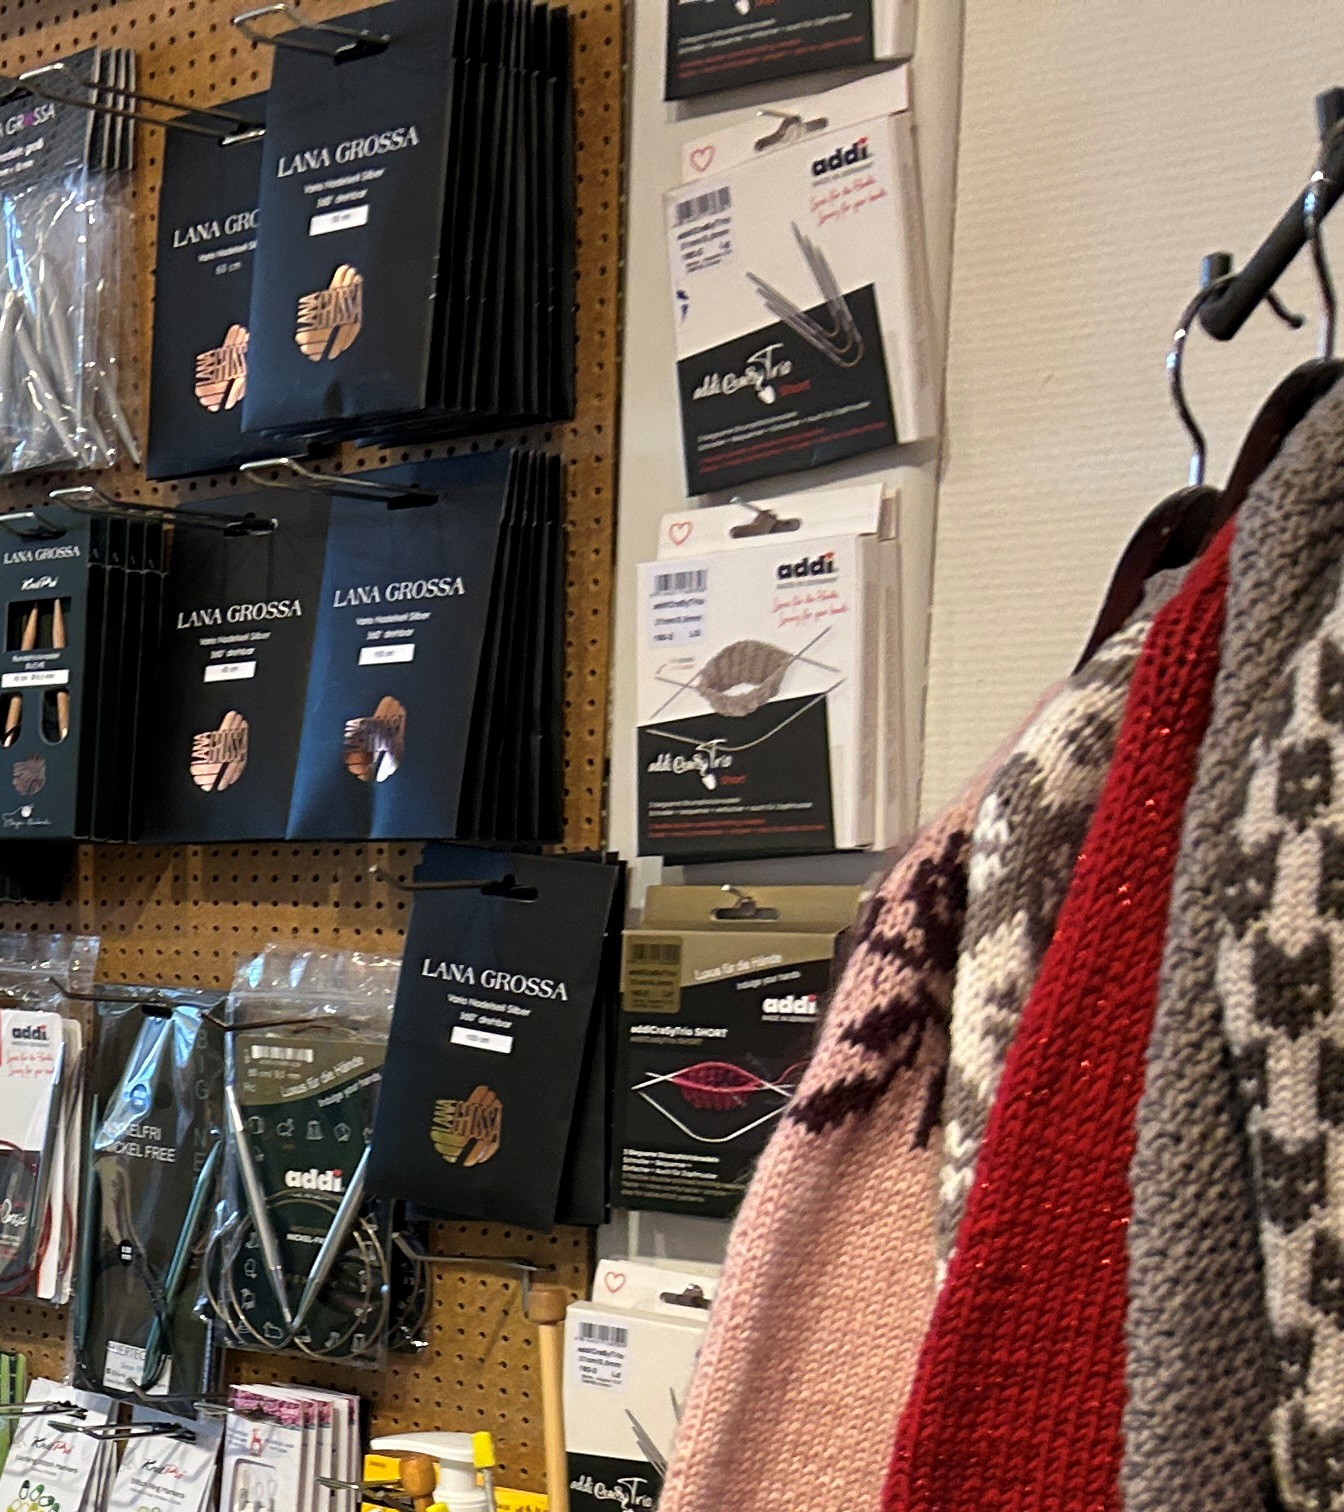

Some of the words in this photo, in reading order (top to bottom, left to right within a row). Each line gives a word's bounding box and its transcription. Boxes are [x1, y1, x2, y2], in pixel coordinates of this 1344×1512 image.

[277, 149, 330, 178] LANA
[335, 126, 420, 165] GROSSA
[812, 136, 869, 177] addi
[172, 220, 220, 249] LANA
[3, 551, 34, 565] LANA
[34, 545, 81, 561] GROSSA
[777, 551, 836, 581] addi
[333, 585, 380, 608] LANA
[384, 576, 466, 603] GROSSA
[177, 609, 221, 630] LANA
[227, 599, 303, 624] GROSSA
[421, 958, 475, 985] LANA
[480, 969, 568, 1001] GROSSA
[762, 993, 818, 1015] addi
[12, 1024, 47, 1042] addi
[144, 1147, 176, 1163] FREE
[285, 1169, 343, 1192] addi
